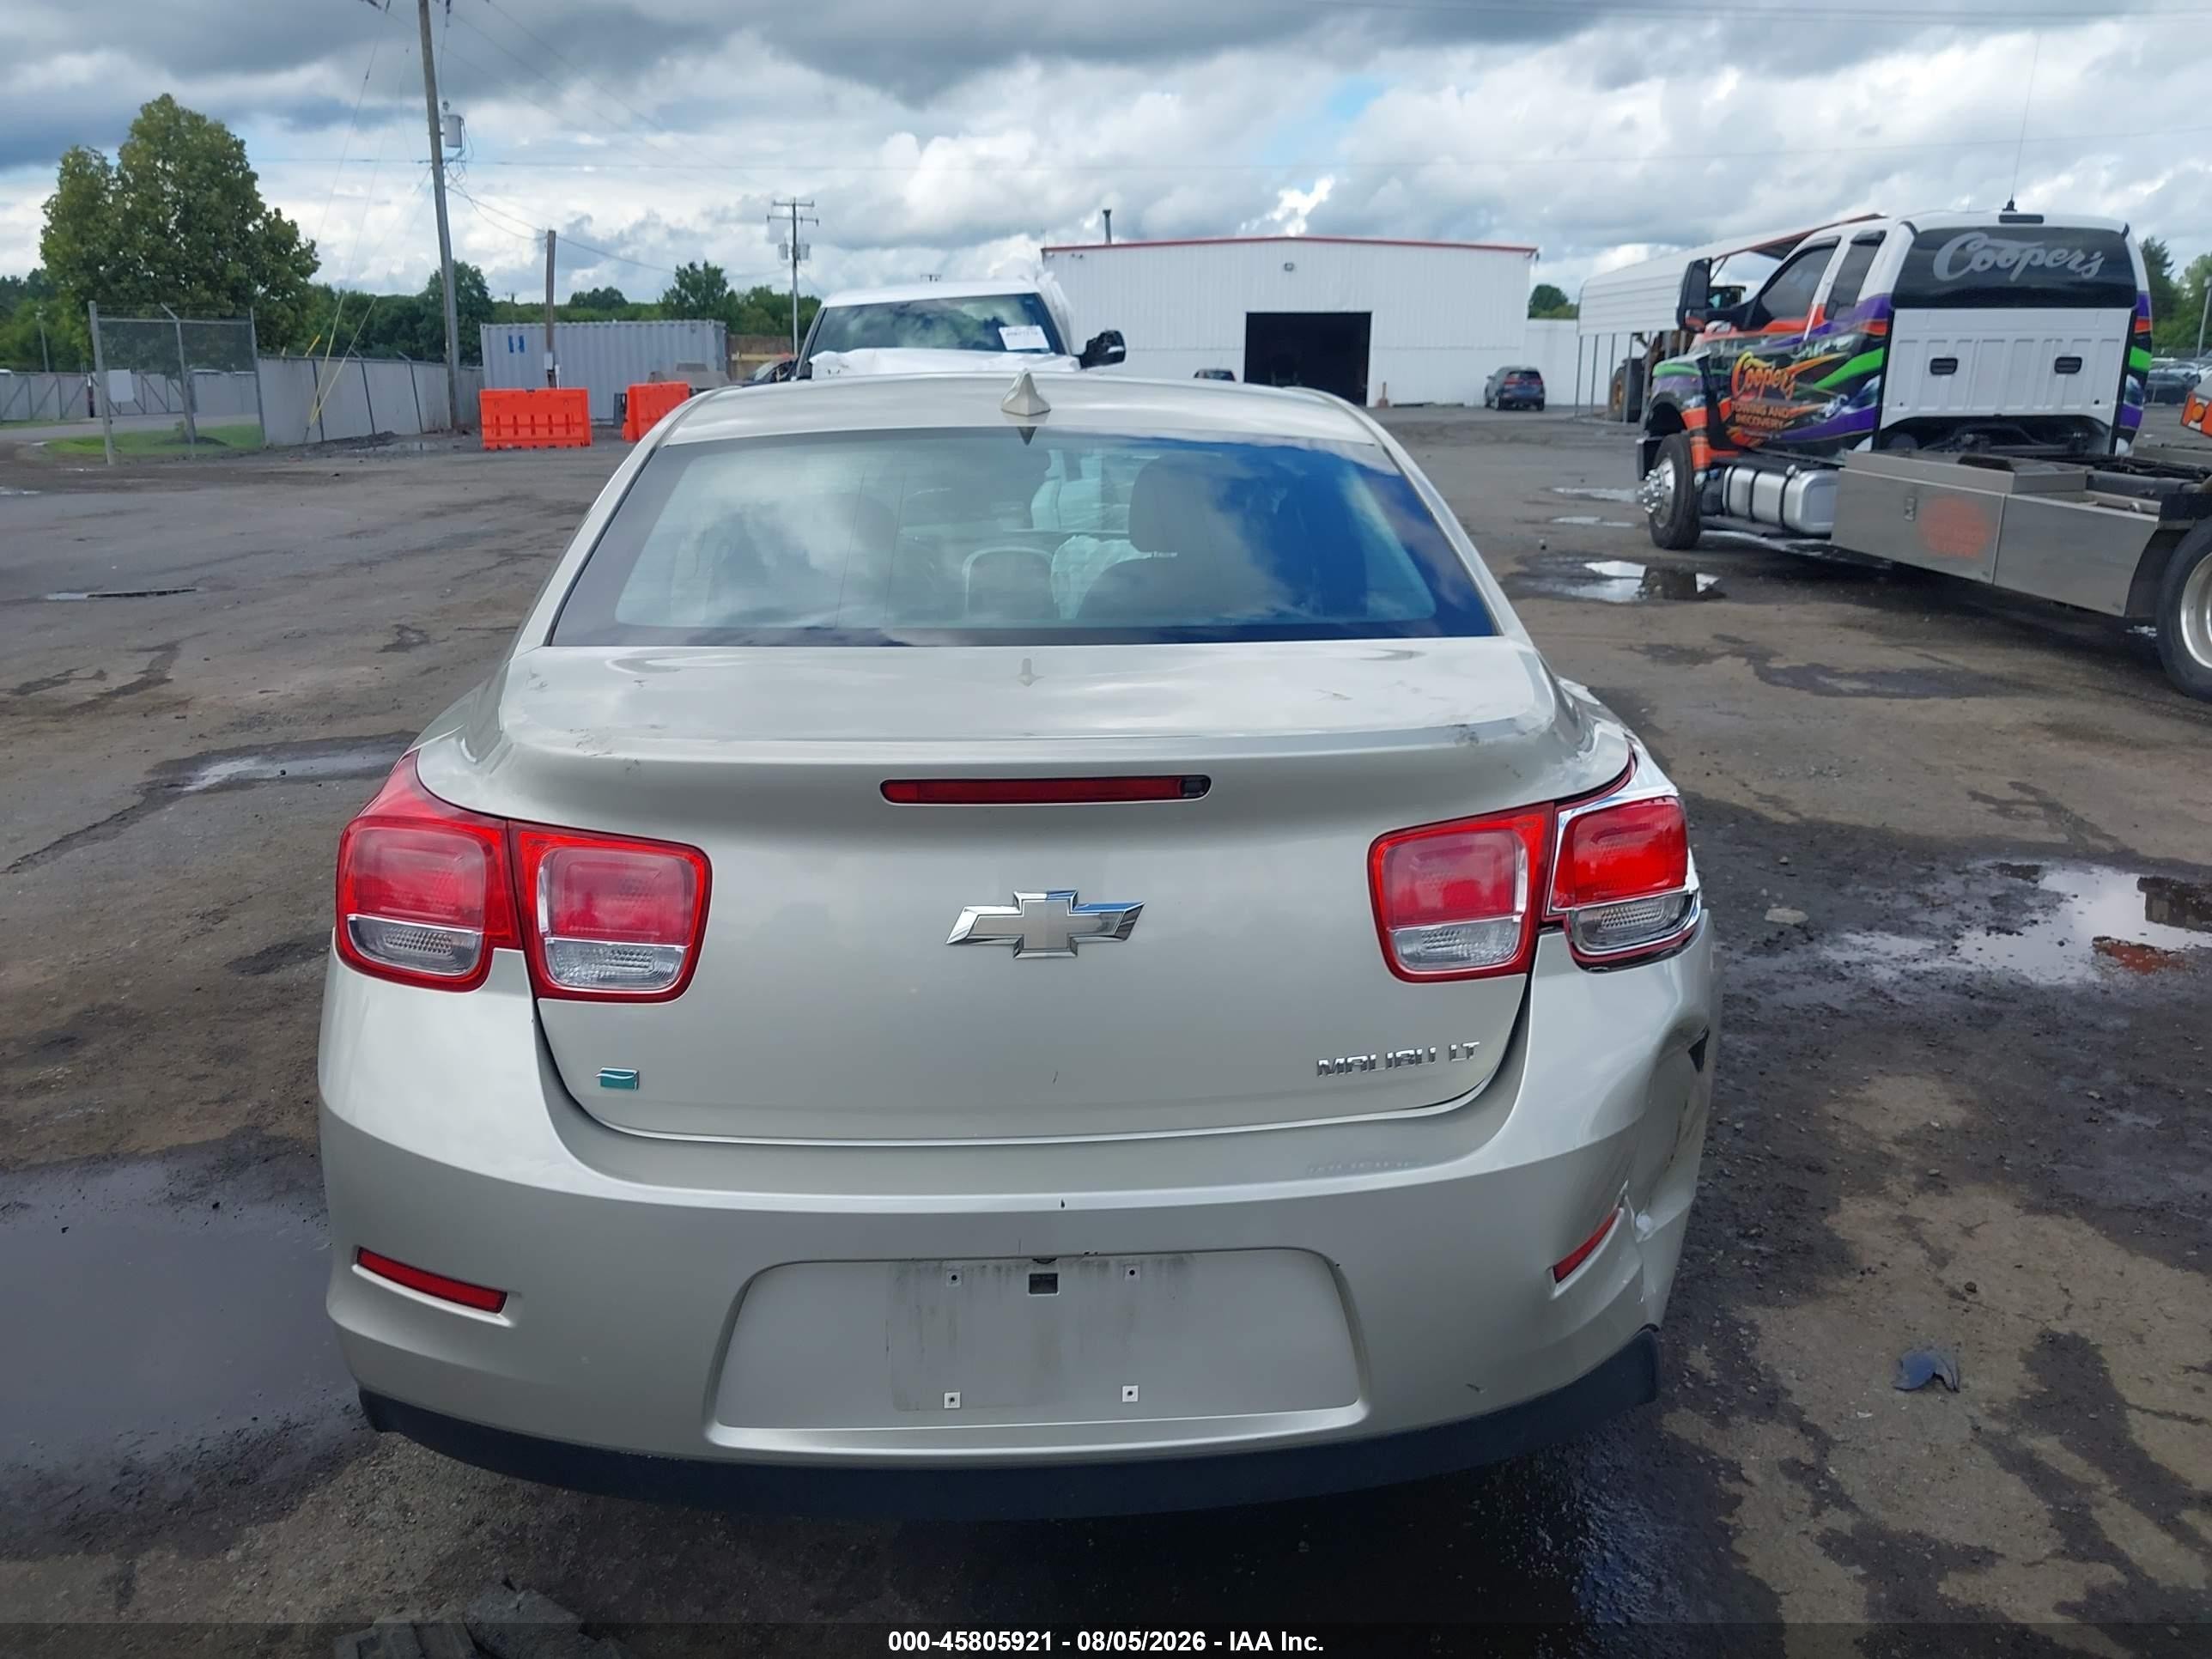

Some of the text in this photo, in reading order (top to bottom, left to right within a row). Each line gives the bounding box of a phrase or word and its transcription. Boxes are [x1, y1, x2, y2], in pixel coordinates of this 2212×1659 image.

[1933, 231, 2106, 283] Cooper's
[1316, 1041, 1480, 1078] MALIBU LT
